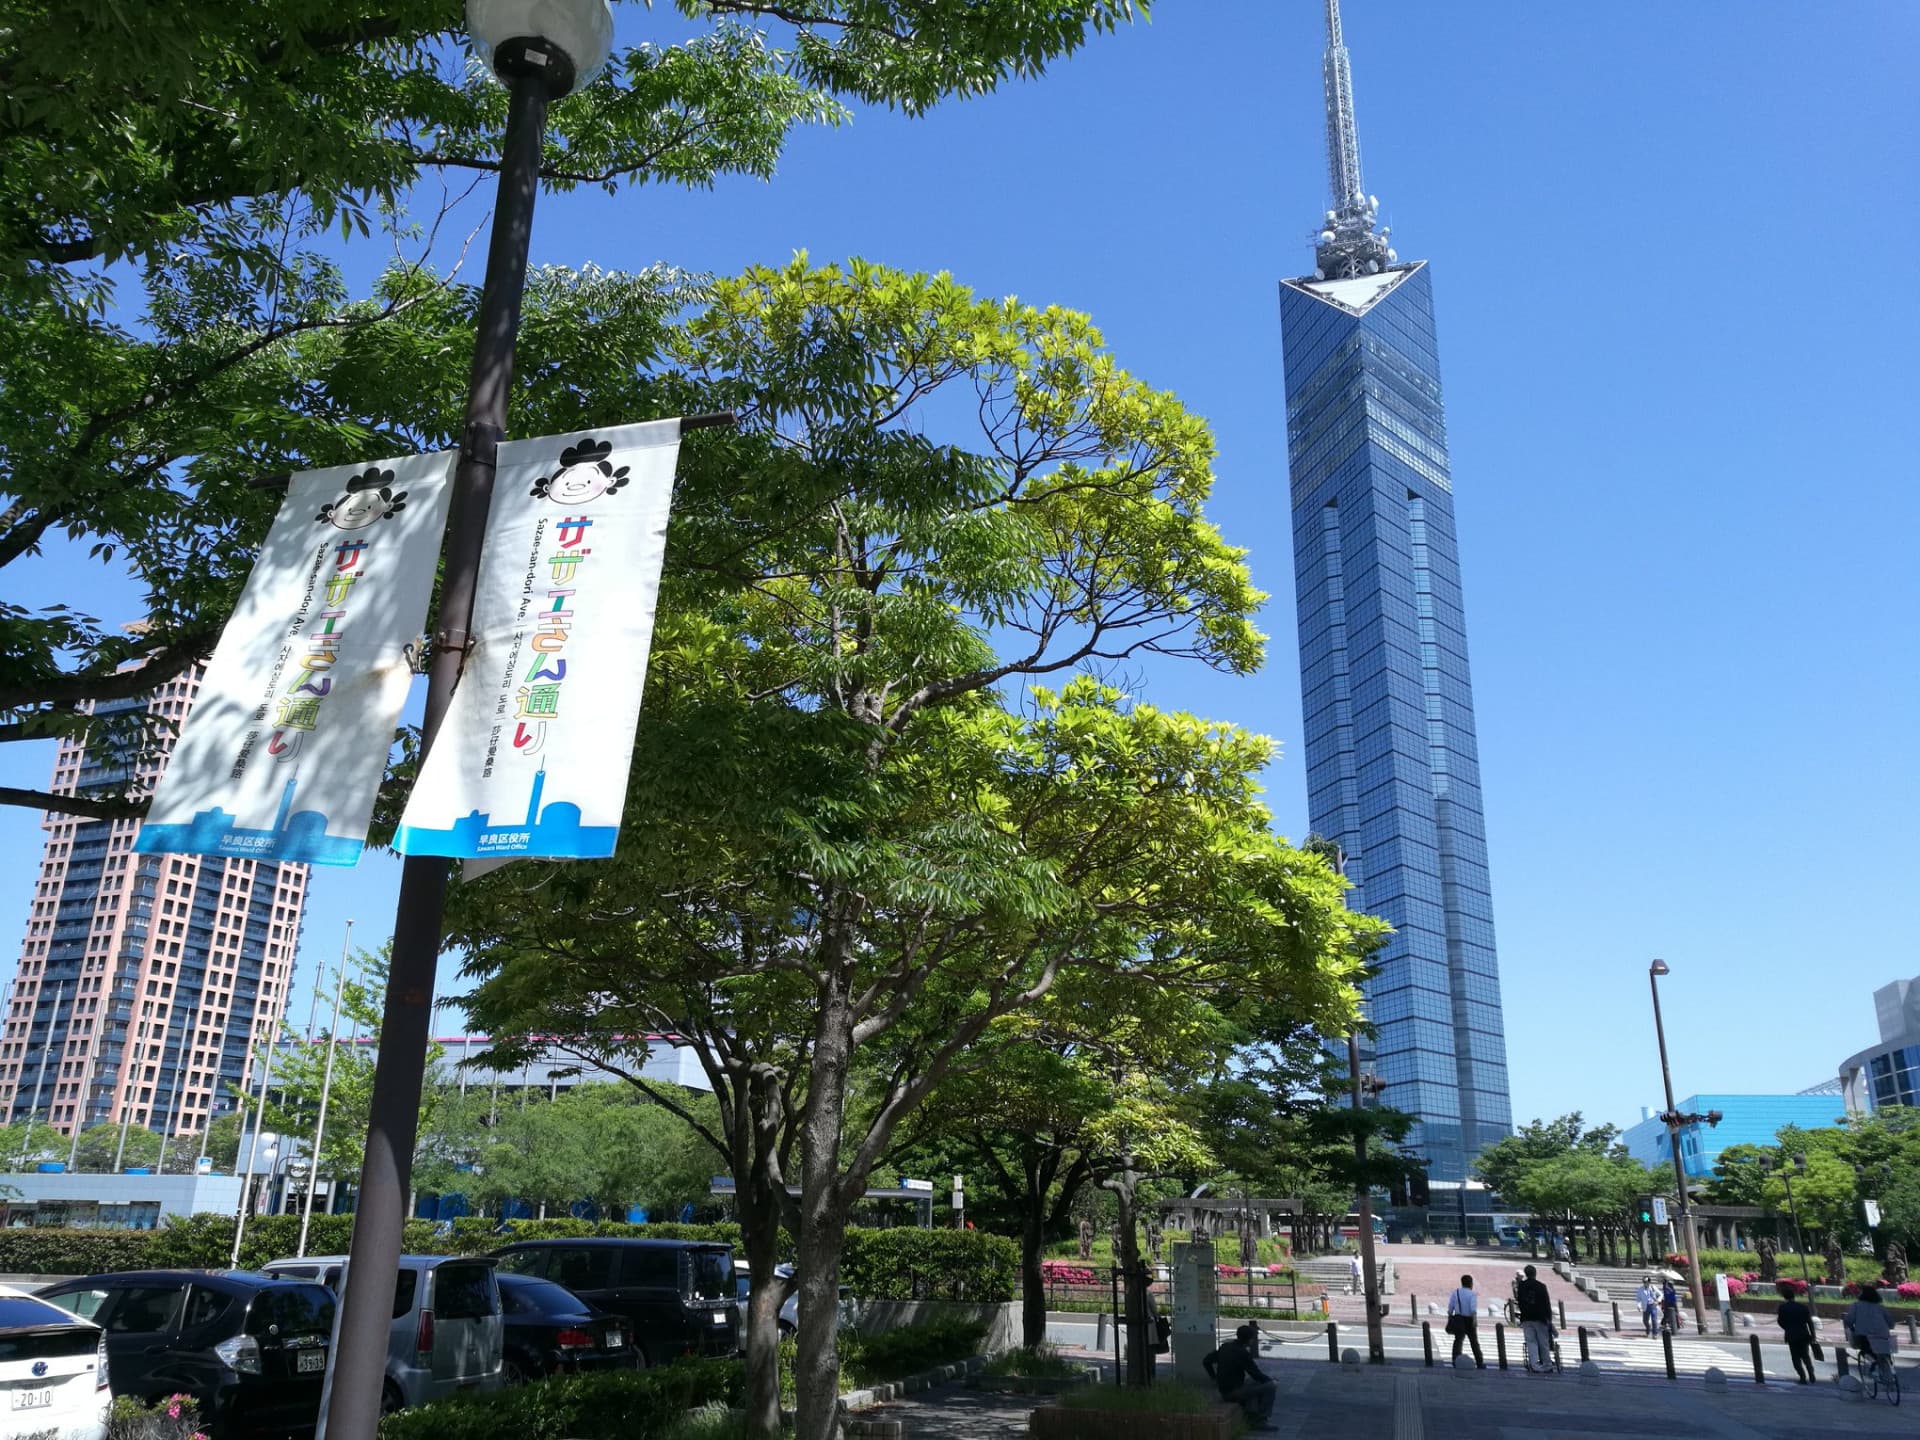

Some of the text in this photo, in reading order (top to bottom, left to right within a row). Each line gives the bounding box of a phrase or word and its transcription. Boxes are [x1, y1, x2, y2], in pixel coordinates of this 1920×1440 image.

[291, 541, 329, 638] Sazae-san-dori Ave.
[516, 517, 548, 623] Sazae-san-dori Ave.
[267, 539, 369, 764] サザエさん通り
[512, 515, 593, 757] サザエさん通り
[221, 834, 278, 849] 早良区役所
[478, 832, 531, 846] 早良区役所
